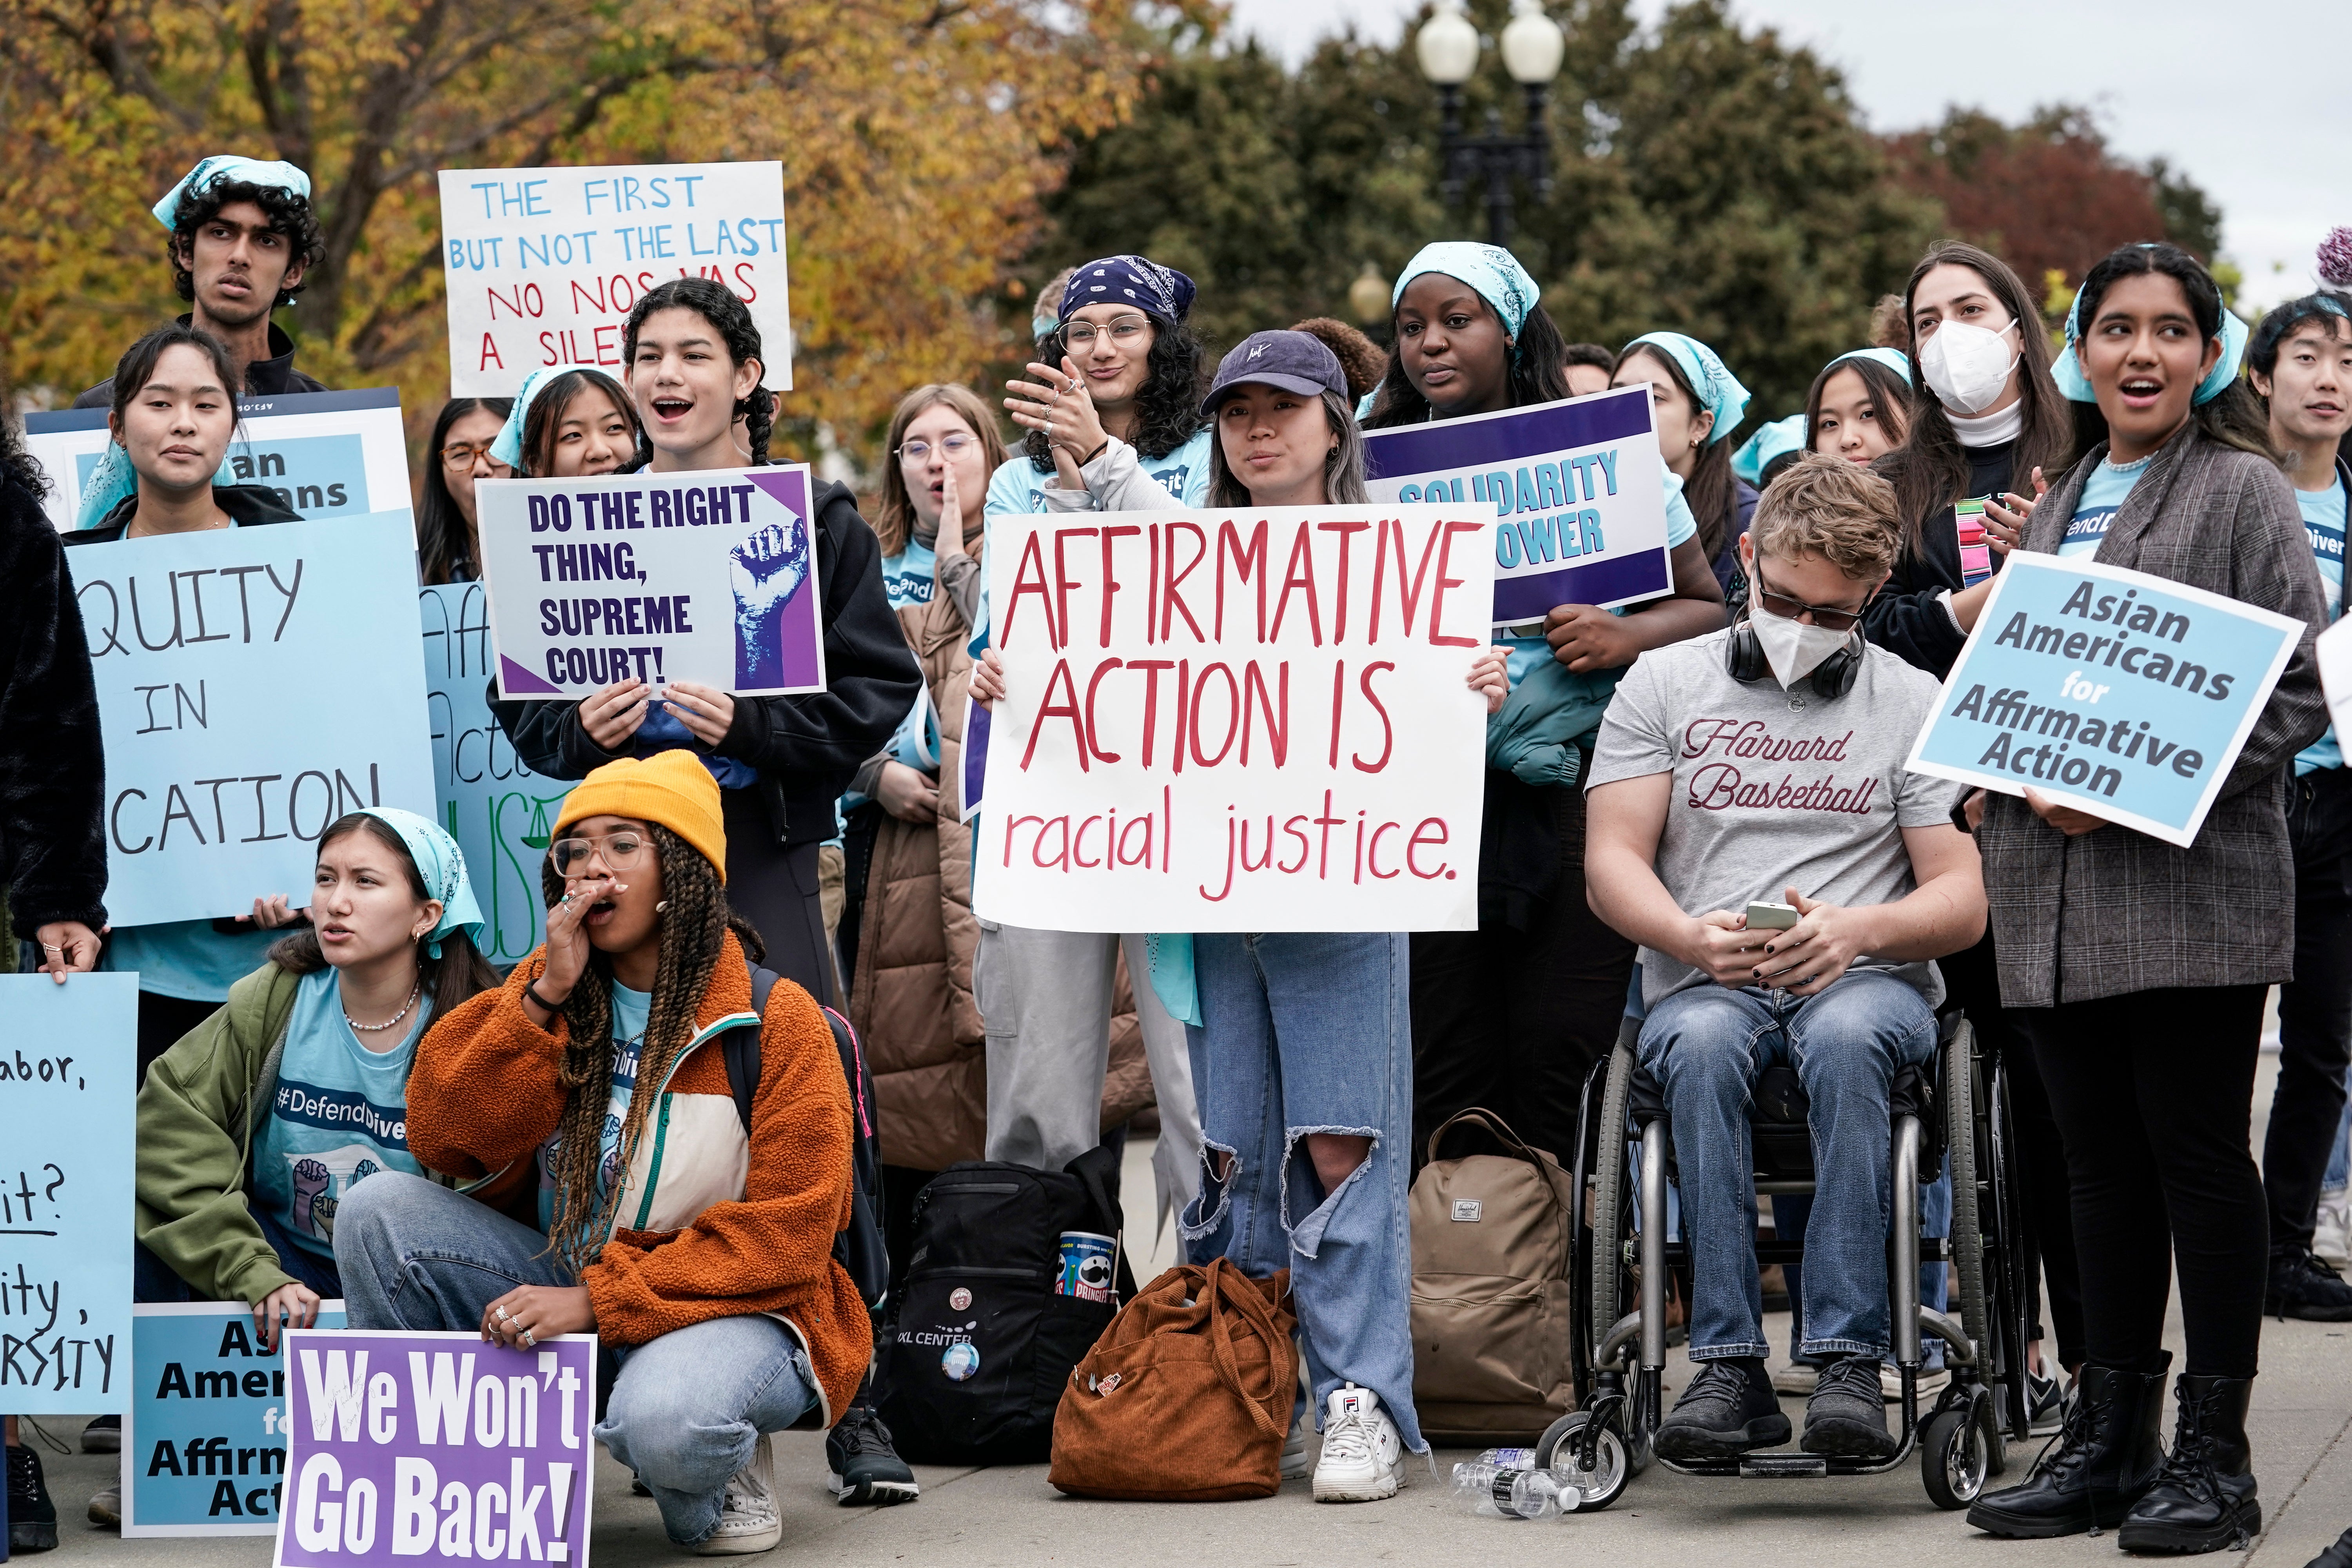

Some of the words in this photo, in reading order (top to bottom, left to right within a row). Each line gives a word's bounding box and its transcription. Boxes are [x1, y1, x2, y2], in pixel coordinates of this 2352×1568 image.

[471, 179, 551, 218] THE
[584, 176, 703, 215] FIRST
[449, 237, 503, 270] BUT
[519, 230, 597, 269] NOT
[615, 225, 675, 261] THE
[688, 218, 783, 256] LAST
[488, 283, 544, 320] NO
[479, 332, 504, 371] A
[539, 325, 628, 366] SILE
[528, 494, 571, 532] DO
[577, 491, 644, 530] THE
[650, 485, 755, 528] RIGHT
[532, 541, 646, 586] THING,
[1496, 508, 1605, 569] OWER
[78, 559, 303, 657] QUITY
[1000, 519, 1486, 654] AFFIRMATIVE
[2060, 581, 2191, 643] Asian
[540, 595, 693, 636] SUPREME
[546, 647, 665, 685] COURT!
[1994, 611, 2235, 701] Americans
[134, 679, 207, 734] IN
[2061, 670, 2110, 704] for
[1020, 657, 1288, 777] ACTION
[1329, 659, 1395, 774] IS
[1681, 719, 1853, 762] Harvard
[1951, 684, 2203, 779] Affirmative
[1688, 763, 1878, 815] Basketball
[1977, 732, 2123, 797] Action
[1003, 785, 1172, 875] racial
[1199, 789, 1457, 902] justice.
[1076, 1283, 1108, 1303] PRINGLES
[916, 1332, 972, 1346] CENTER
[299, 1350, 397, 1445] We
[408, 1351, 581, 1450] Won't
[1110, 1375, 1120, 1383] WE
[296, 1452, 377, 1555] Go
[392, 1457, 572, 1562] Back!
